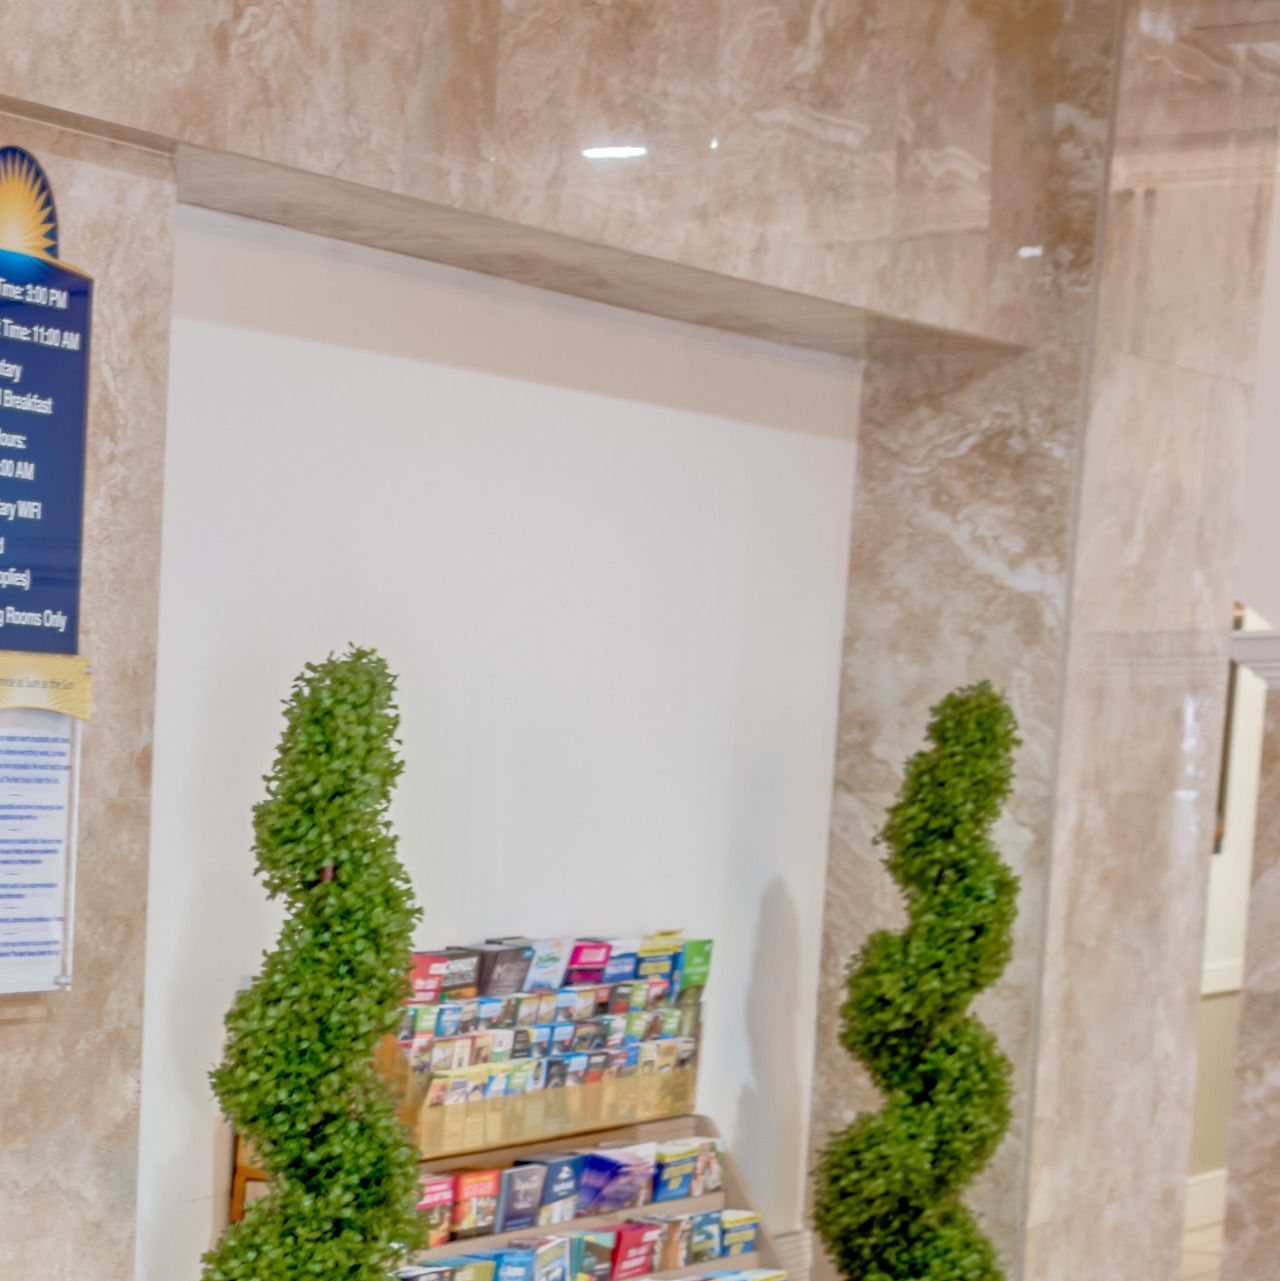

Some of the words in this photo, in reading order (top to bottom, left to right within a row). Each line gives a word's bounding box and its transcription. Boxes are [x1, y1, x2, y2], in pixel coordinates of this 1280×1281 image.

[25, 283, 48, 305] 3:00
[48, 288, 69, 309] PM
[2, 318, 31, 341] Time:
[32, 325, 61, 347] 11:00
[61, 331, 81, 350] AM
[3, 389, 54, 415] Breakfast
[15, 461, 35, 481] AM
[5, 605, 42, 627] Rooms
[42, 608, 68, 632] Only
